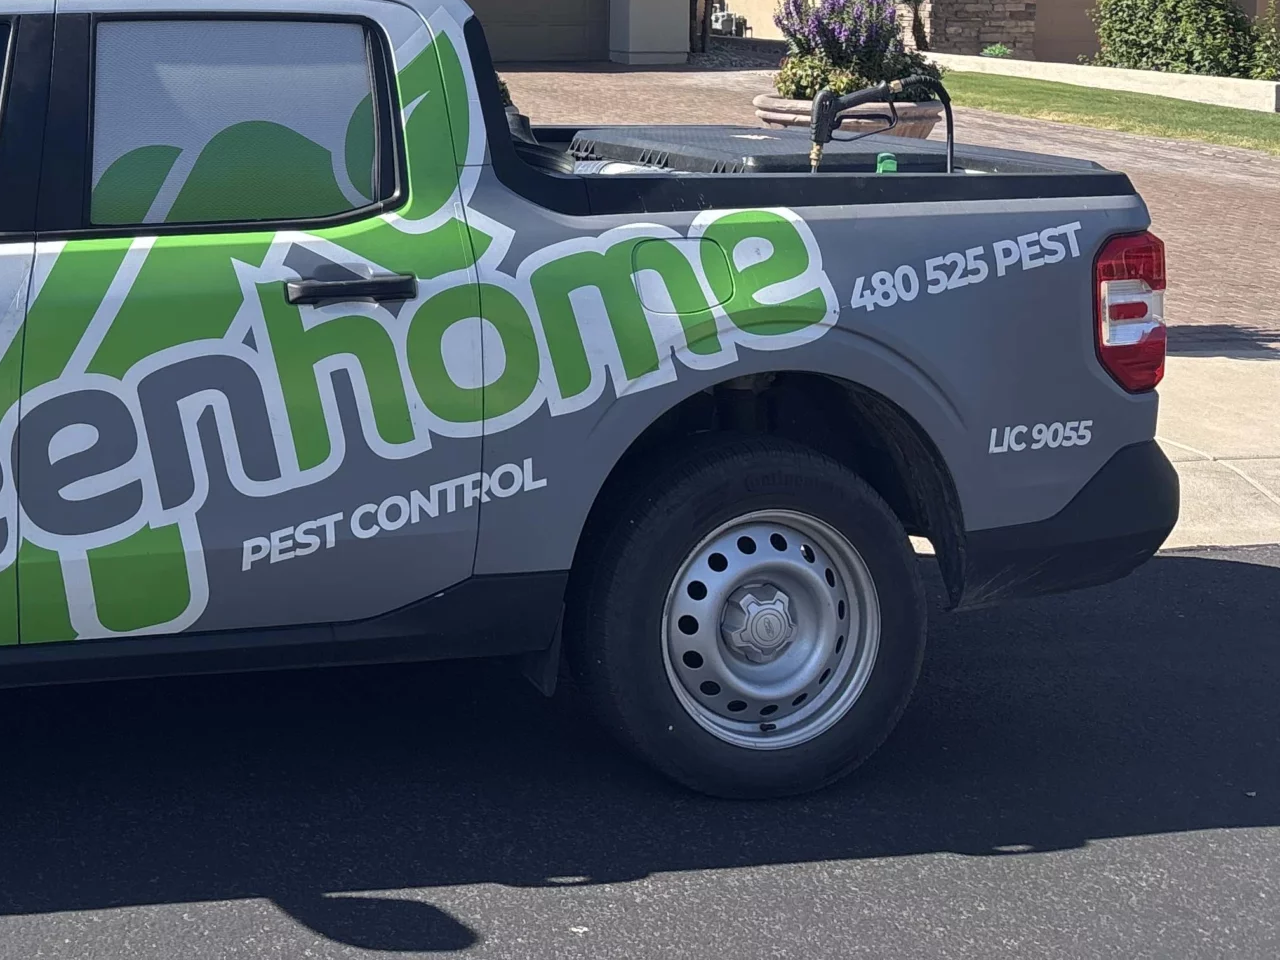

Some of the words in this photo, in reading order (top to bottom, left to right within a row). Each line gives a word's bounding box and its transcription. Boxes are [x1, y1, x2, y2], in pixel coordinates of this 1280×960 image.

[851, 264, 919, 311] 480
[925, 246, 988, 295] 525
[993, 221, 1082, 277] PEST
[988, 425, 1028, 454] LIC
[1031, 420, 1093, 450] 9055
[241, 512, 345, 572] PEST
[350, 457, 547, 538] CONTROL
